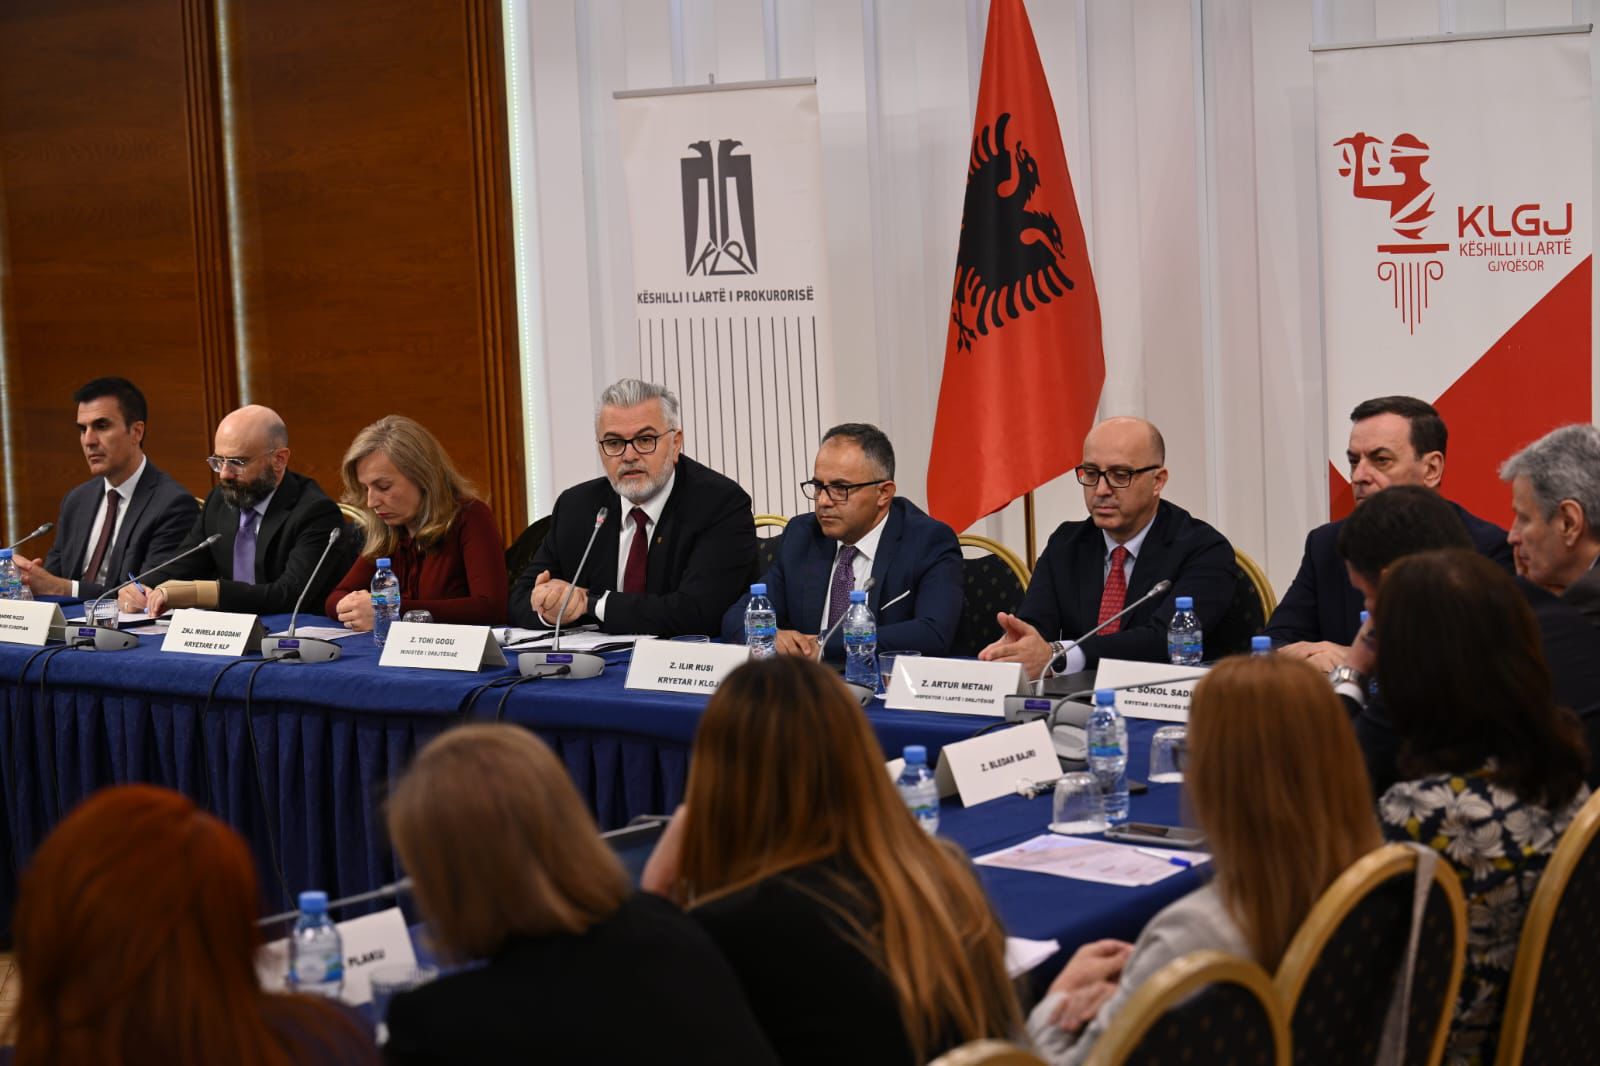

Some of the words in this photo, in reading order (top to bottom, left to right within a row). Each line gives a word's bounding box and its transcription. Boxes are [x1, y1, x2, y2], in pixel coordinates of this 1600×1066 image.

[1457, 203, 1573, 238] KLGJ
[1459, 240, 1516, 256] KËSHILLI
[1520, 241, 1524, 255] I
[1528, 238, 1572, 255] LARTË
[1488, 259, 1544, 272] GJYQËSOR
[637, 289, 683, 304] KËSHILLI
[686, 291, 690, 303] I
[692, 287, 726, 303] LARTË
[729, 290, 733, 302] I
[736, 286, 815, 302] PROKURORISË
[678, 662, 694, 670] ILIR
[695, 663, 714, 672] RUSI
[657, 676, 692, 686] KRYETAR
[931, 680, 959, 689] ARTUR
[961, 682, 993, 692] METANI
[1137, 686, 1168, 696] SOKOL
[989, 756, 1016, 770] BLEDAR
